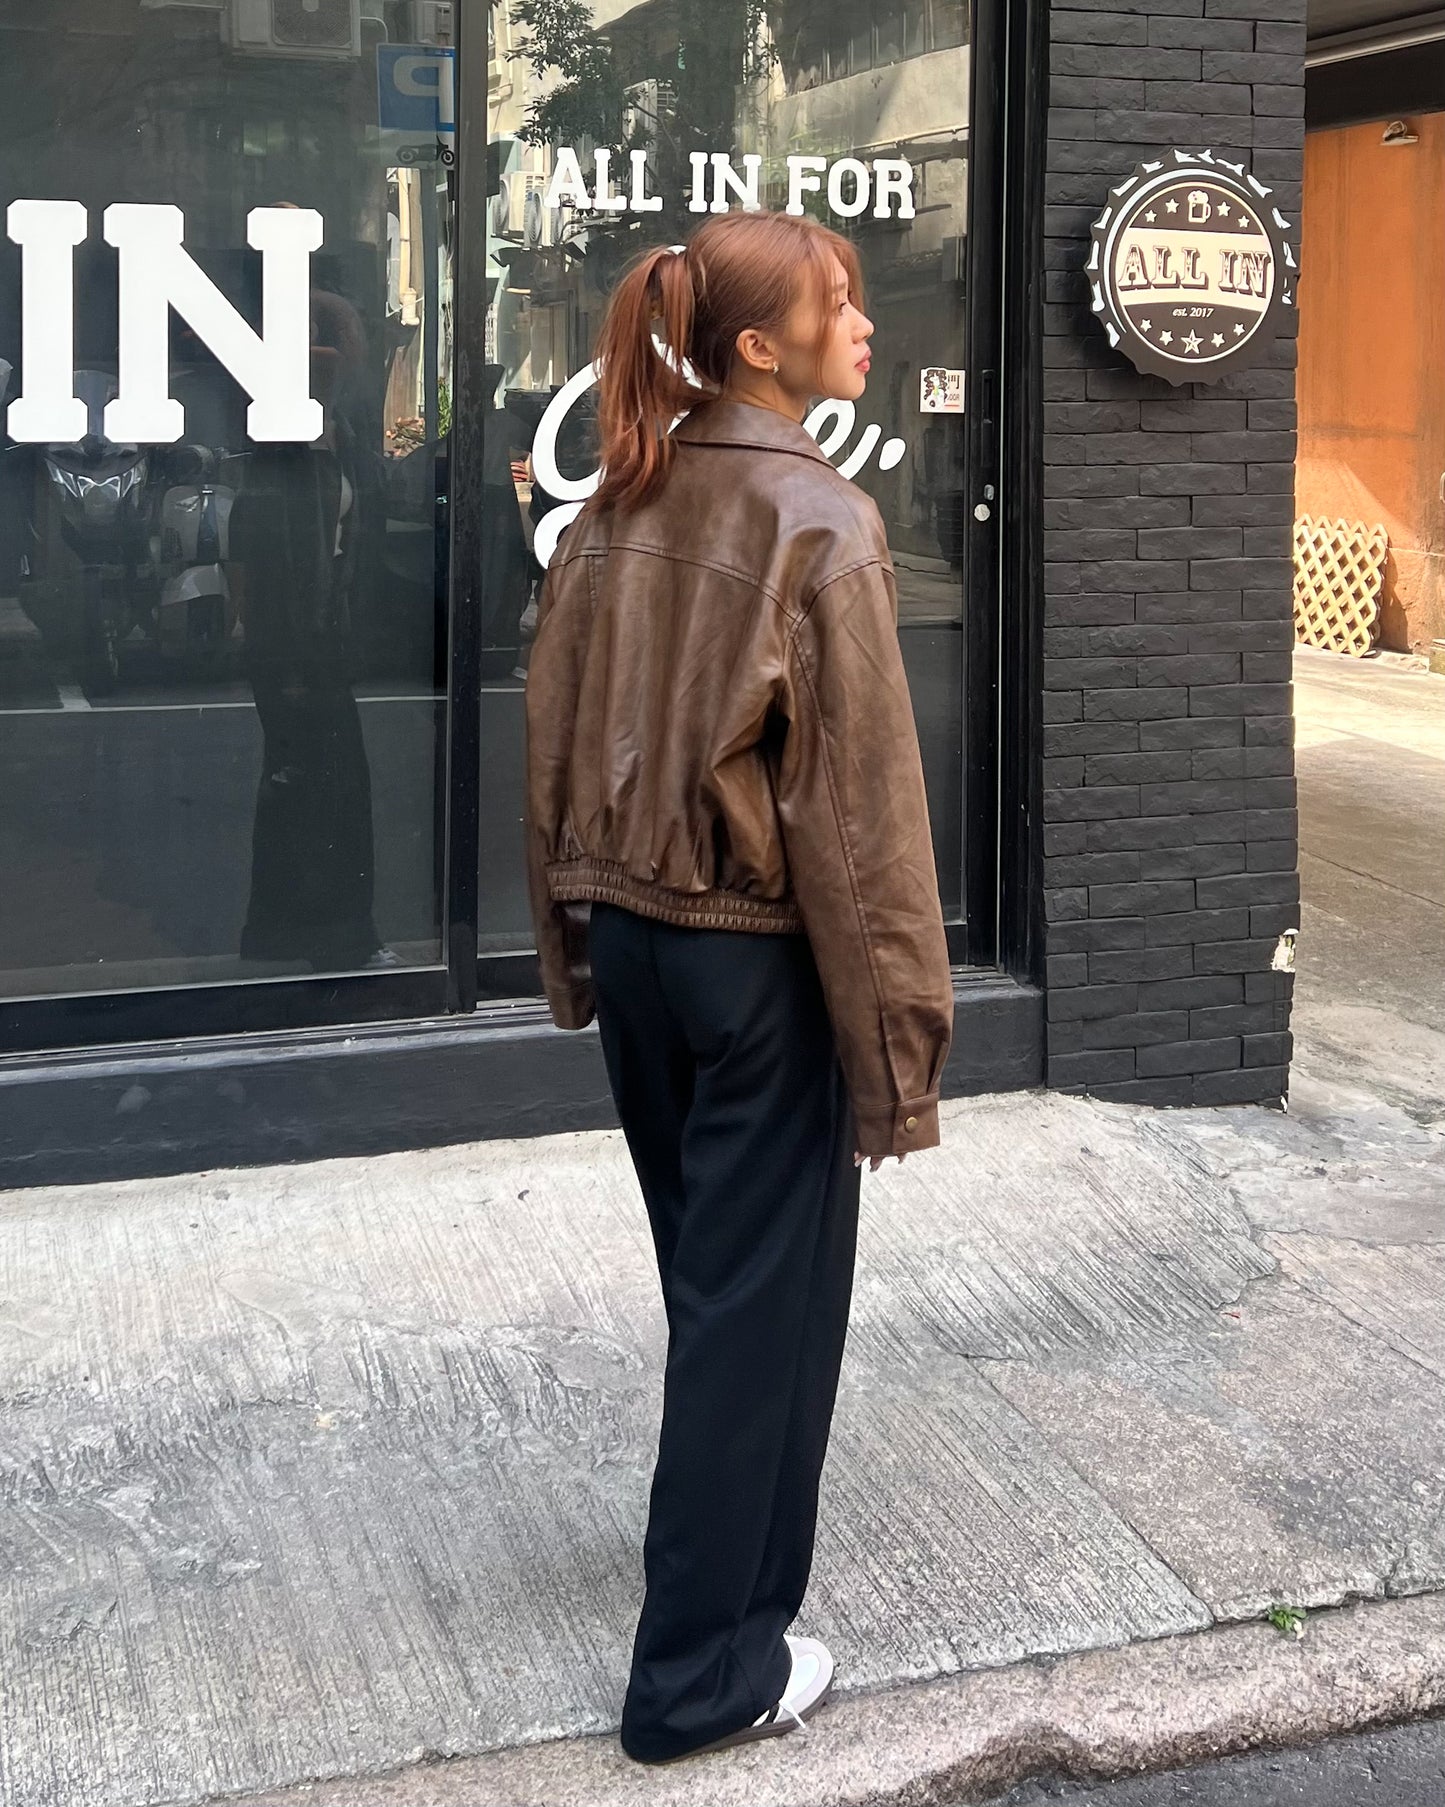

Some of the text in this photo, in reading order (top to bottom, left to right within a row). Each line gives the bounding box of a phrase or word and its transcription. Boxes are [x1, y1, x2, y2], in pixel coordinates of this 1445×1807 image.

[543, 147, 916, 219] ALL IN FOR
[1118, 244, 1271, 299] ALL IN
[7, 199, 324, 443] IN
[1172, 307, 1215, 318] est. 2017
